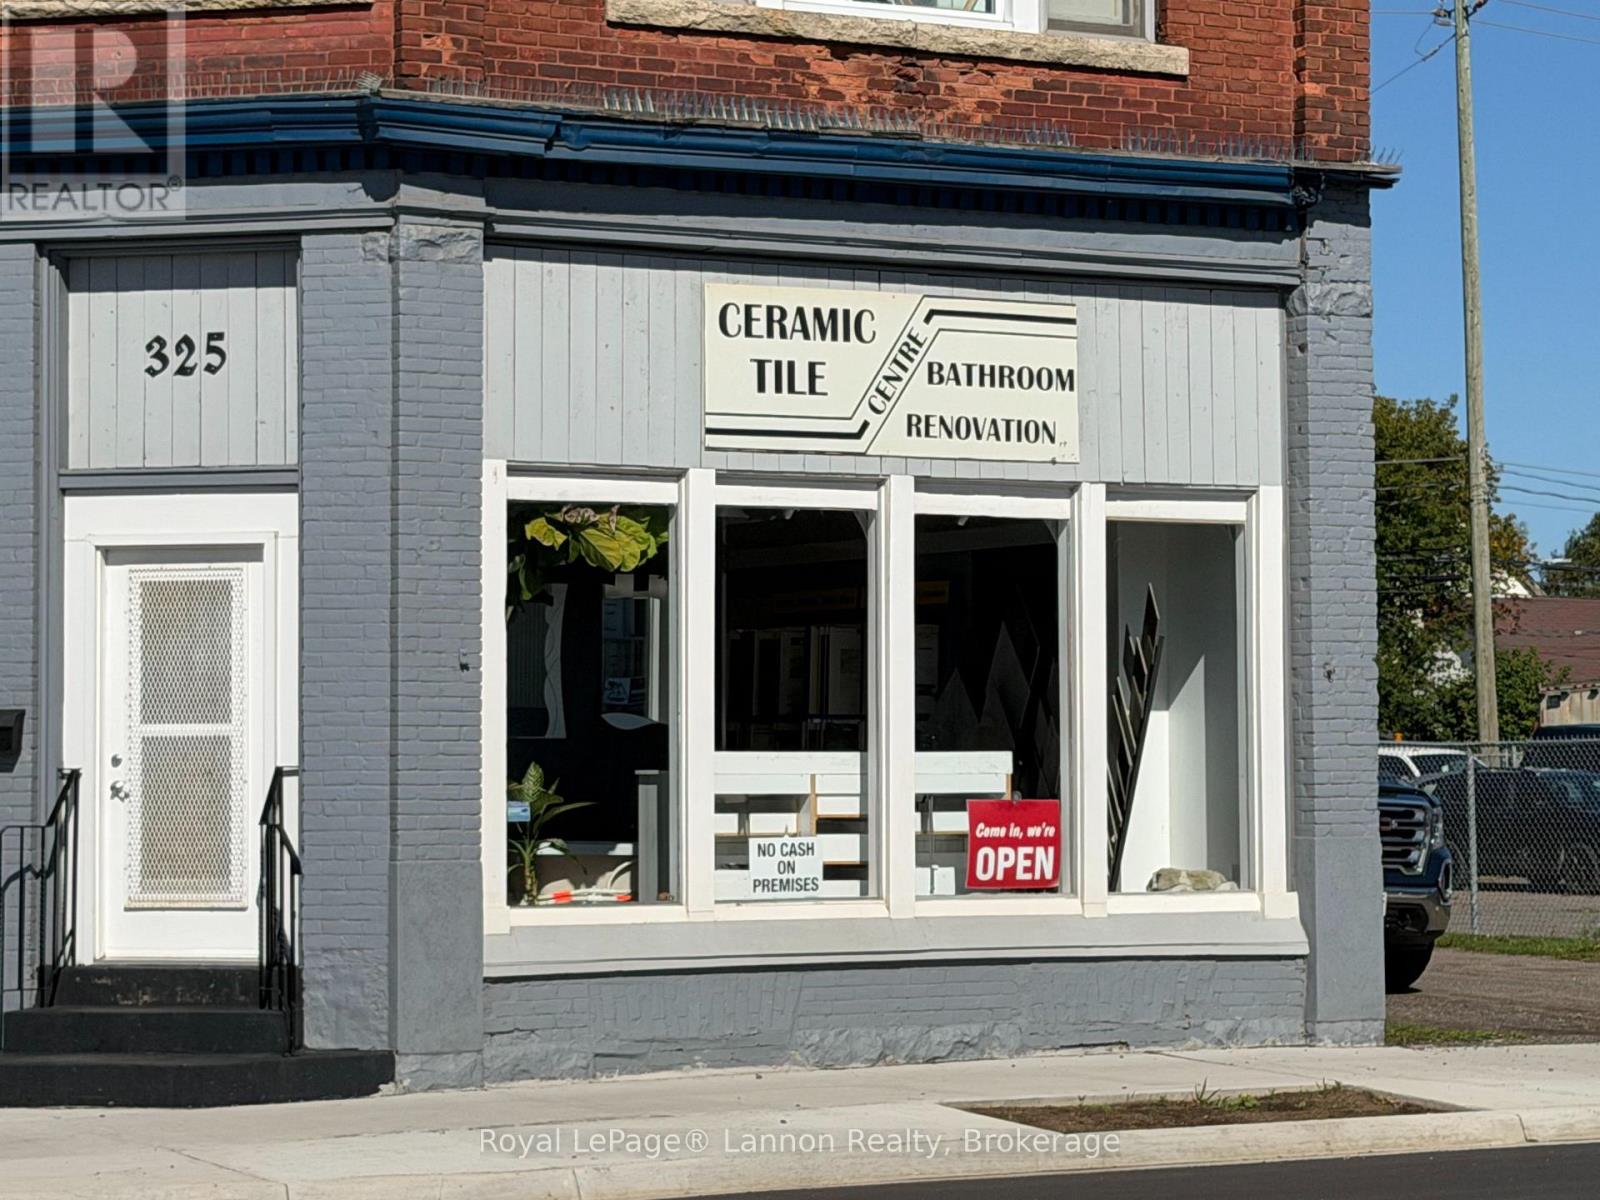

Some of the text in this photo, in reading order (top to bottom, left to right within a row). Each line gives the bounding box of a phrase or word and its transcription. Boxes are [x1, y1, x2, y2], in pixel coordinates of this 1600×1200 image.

[718, 302, 877, 344] CERAMIC
[144, 332, 227, 378] 325
[750, 358, 829, 397] TILE
[867, 327, 931, 416] CENTRE
[927, 361, 1075, 392] BATHROOM
[906, 413, 1056, 445] RENOVATION
[975, 821, 1056, 840] Come in, we're
[757, 841, 815, 858] NO CASH
[975, 846, 1055, 881] OPEN
[777, 860, 796, 875] ON
[752, 877, 820, 894] PREMISES
